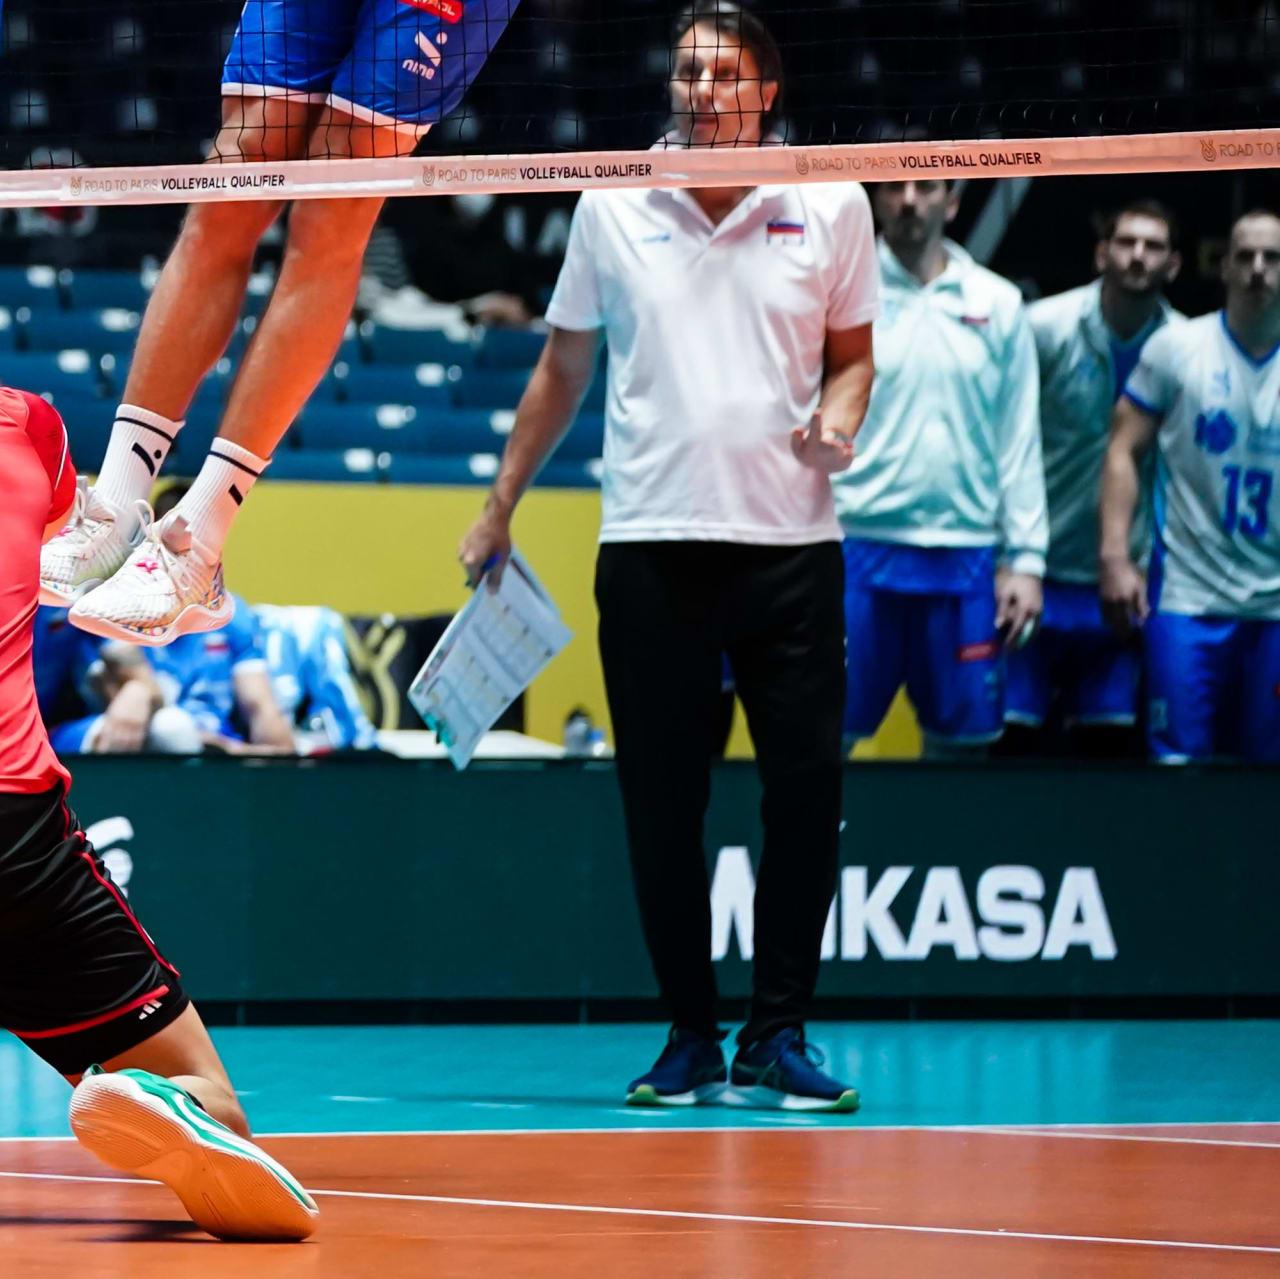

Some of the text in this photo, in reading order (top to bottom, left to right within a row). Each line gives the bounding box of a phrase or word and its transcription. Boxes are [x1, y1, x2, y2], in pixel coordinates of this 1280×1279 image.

[402, 59, 435, 80] nine
[1219, 143, 1253, 157] ROAD
[1256, 142, 1274, 156] TO
[811, 152, 1042, 171] ROAD TO PARIS VOLLEYBALL QUALIFIER
[438, 163, 652, 182] ROAD TO PARIS VOLLEYBALL QUALIFIER
[84, 174, 285, 192] ROAD TO PARIS VOLLEYBALL QUALIFIER
[1222, 464, 1274, 540] 13
